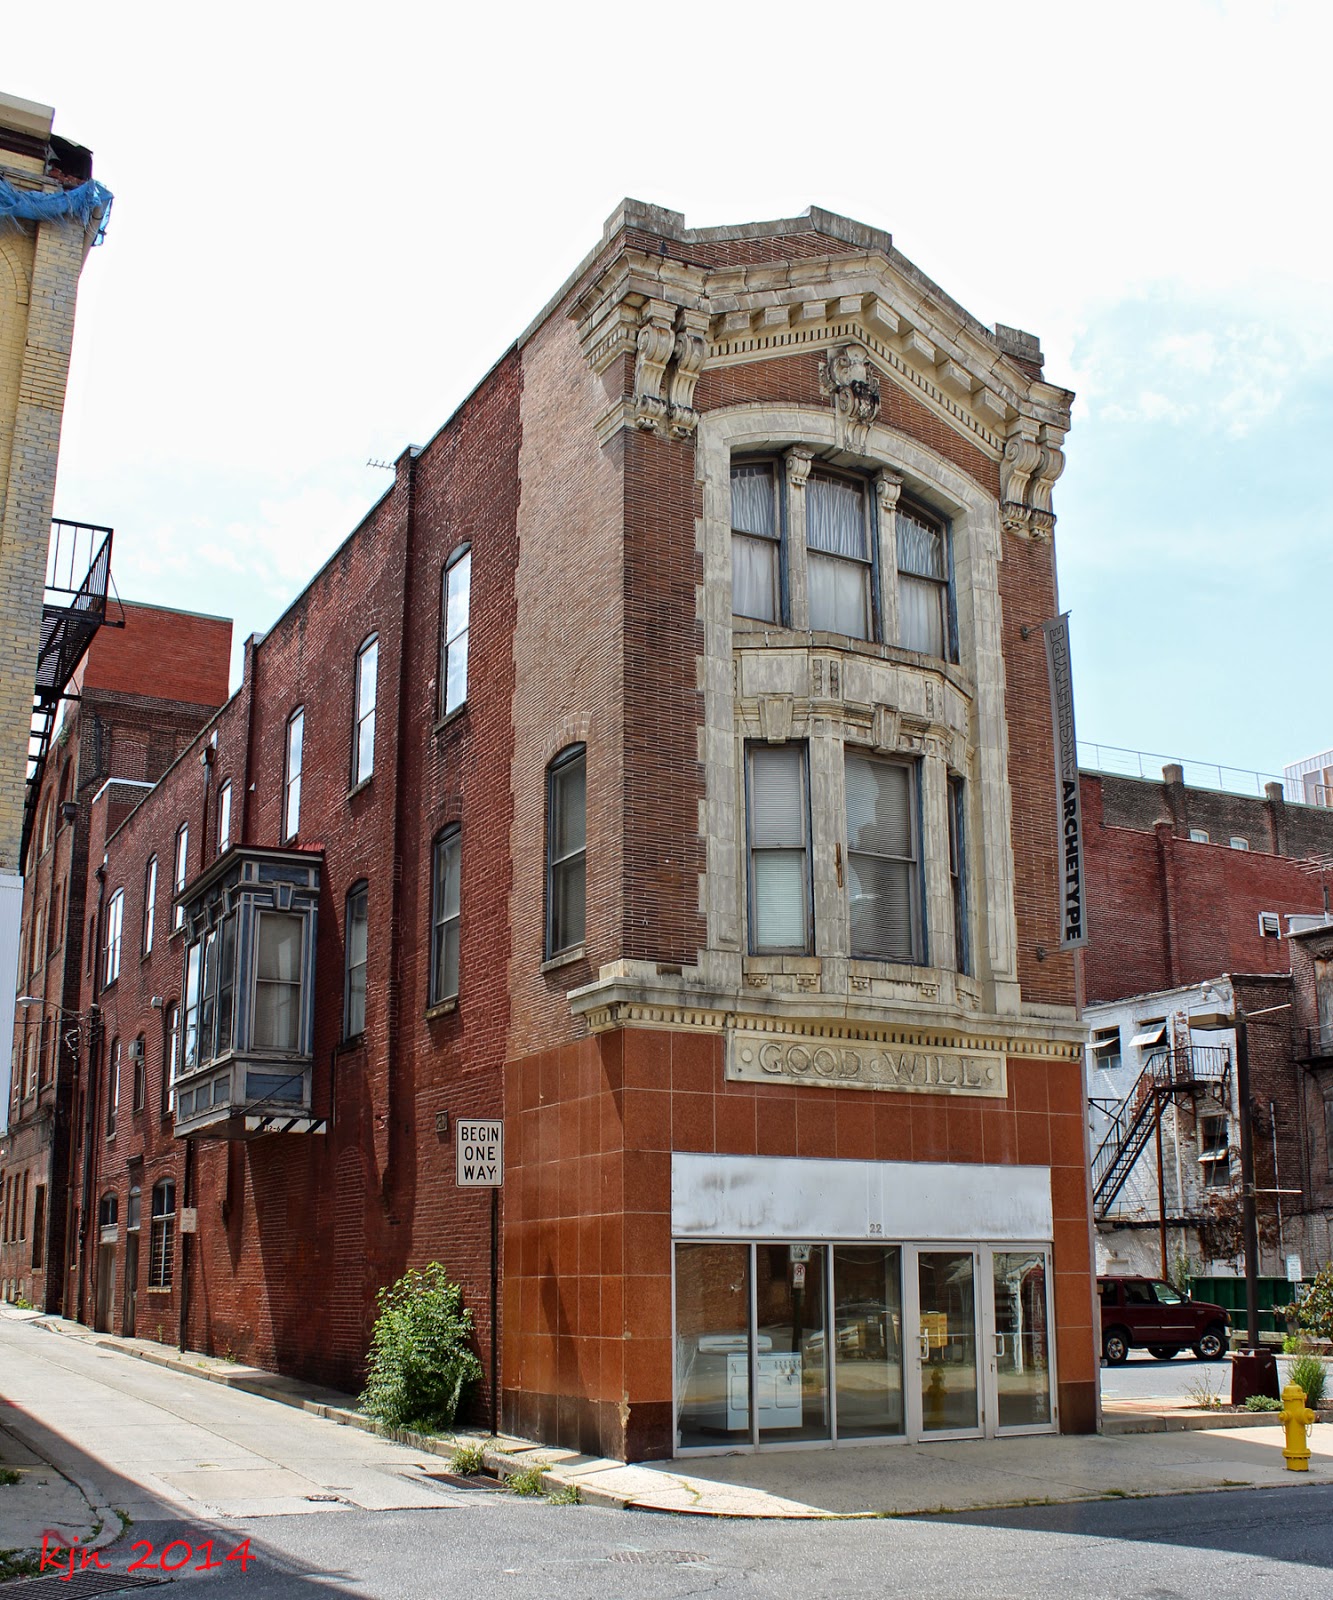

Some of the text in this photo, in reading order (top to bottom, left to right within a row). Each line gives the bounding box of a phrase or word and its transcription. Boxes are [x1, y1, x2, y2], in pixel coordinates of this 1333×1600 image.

[1062, 781, 1081, 941] ARCHETYPE
[759, 1042, 982, 1088] GOOD WILL
[461, 1126, 499, 1141] BEGIN
[464, 1146, 496, 1161] ONE
[463, 1165, 496, 1180] WAY
[869, 1223, 882, 1233] 22
